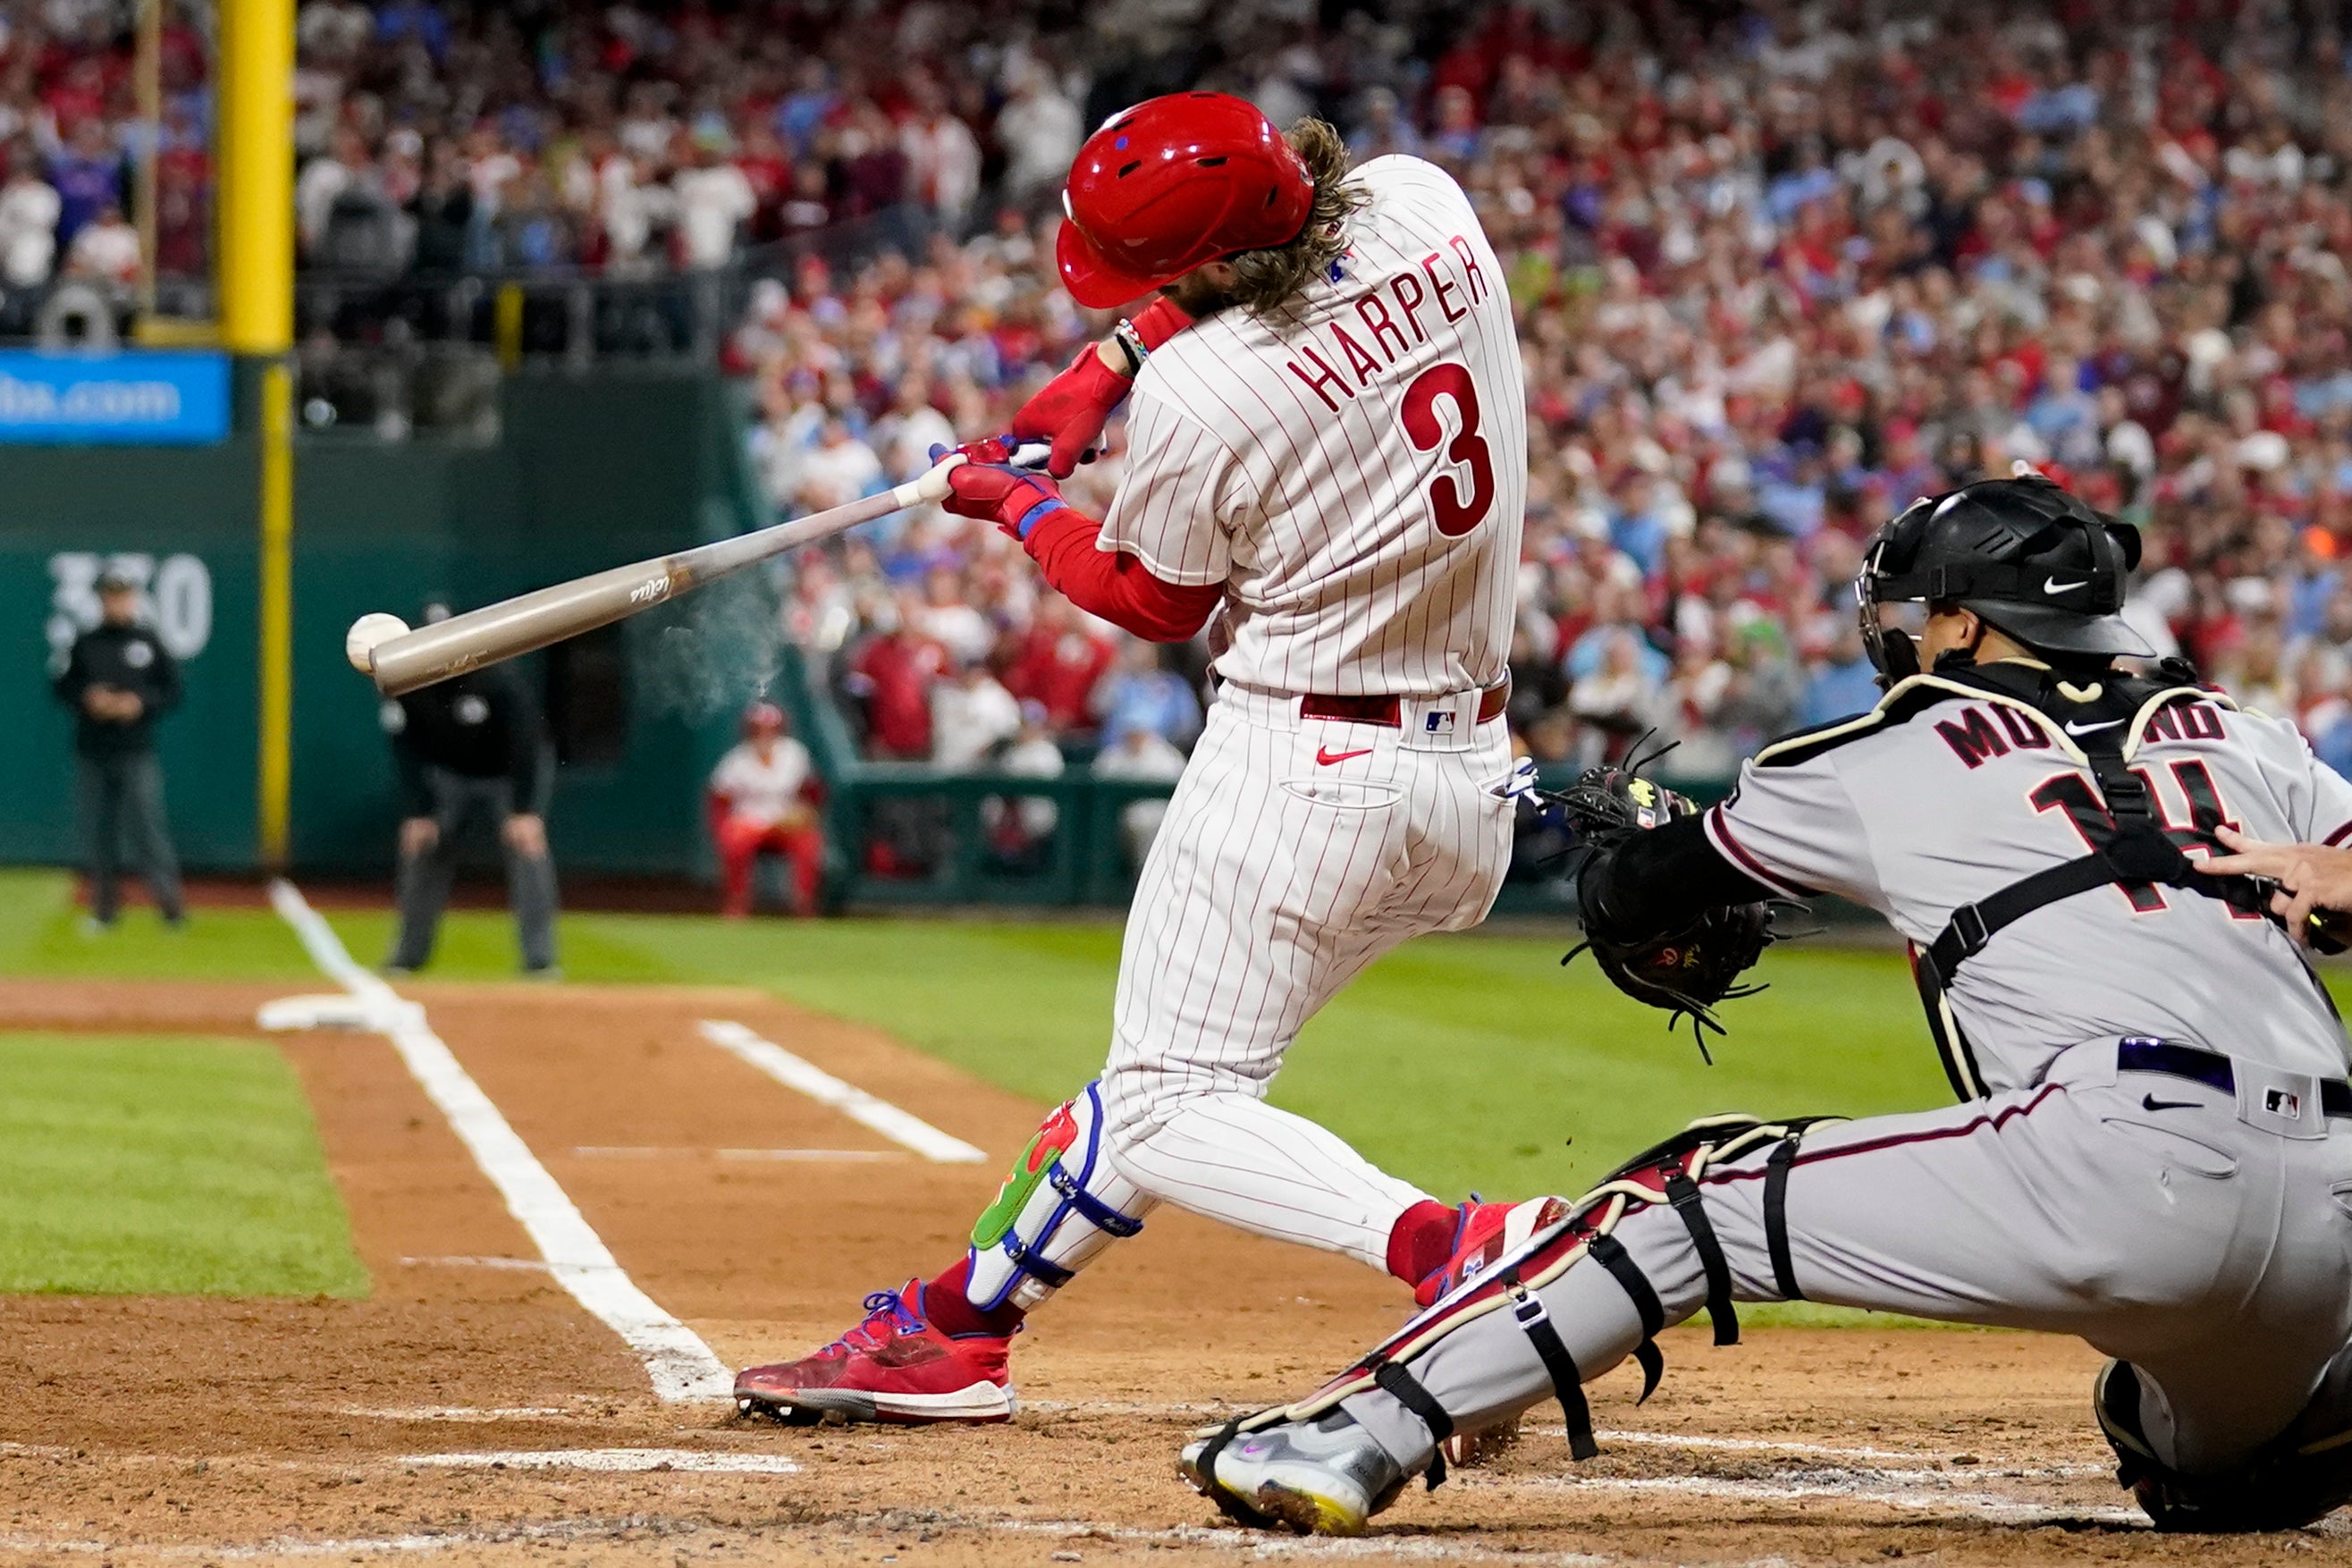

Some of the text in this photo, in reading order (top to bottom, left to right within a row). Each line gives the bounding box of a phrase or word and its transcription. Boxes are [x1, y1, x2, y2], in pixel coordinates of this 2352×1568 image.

[1286, 234, 1488, 413] HARPER
[1400, 361, 1496, 539] 3
[1933, 701, 2226, 770] MONO
[2024, 755, 2263, 921] 14
